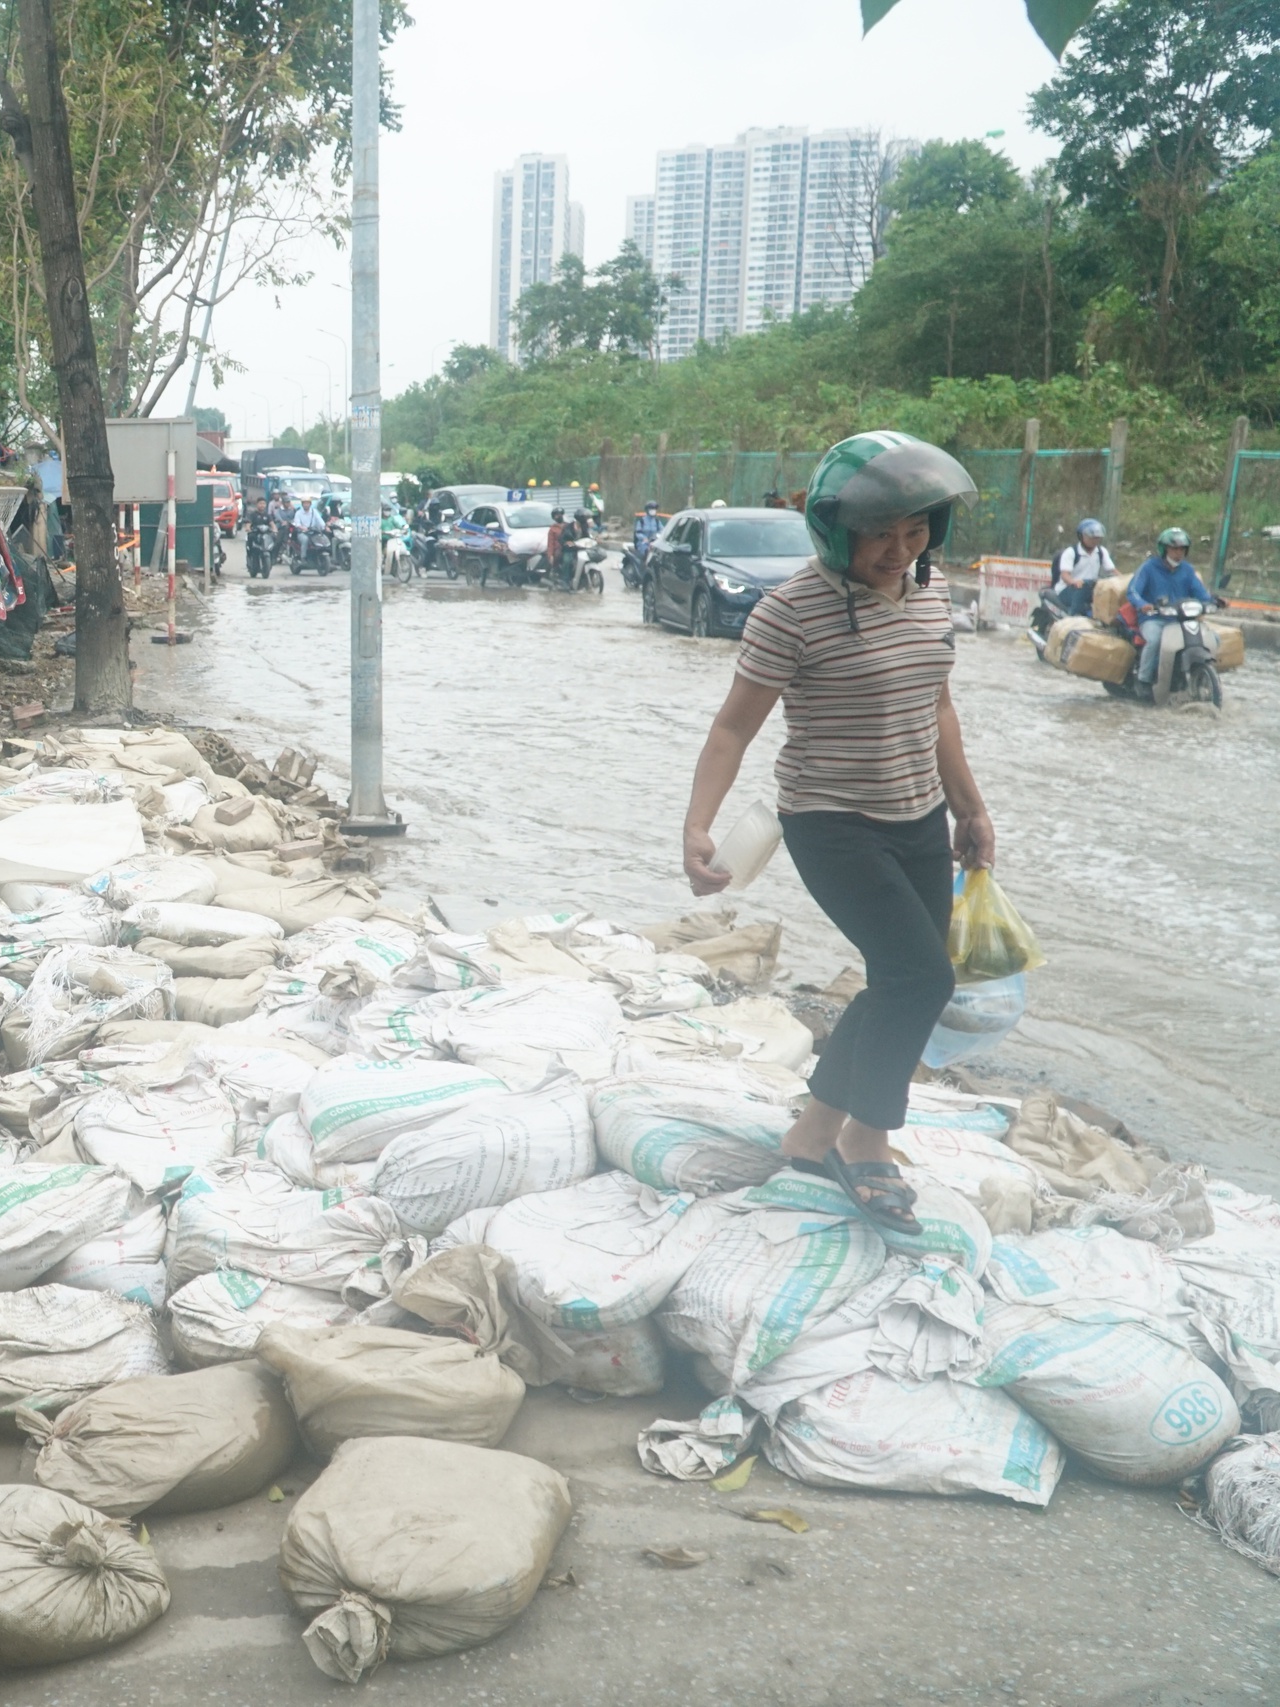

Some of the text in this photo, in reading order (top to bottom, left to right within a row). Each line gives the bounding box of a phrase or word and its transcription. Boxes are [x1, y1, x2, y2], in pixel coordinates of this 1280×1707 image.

[329, 1101, 357, 1116] CÔNG
[777, 1181, 807, 1195] CÔNG
[811, 1264, 832, 1289] NEW
[793, 1283, 817, 1313] HOPE
[1162, 1387, 1218, 1438] 986
